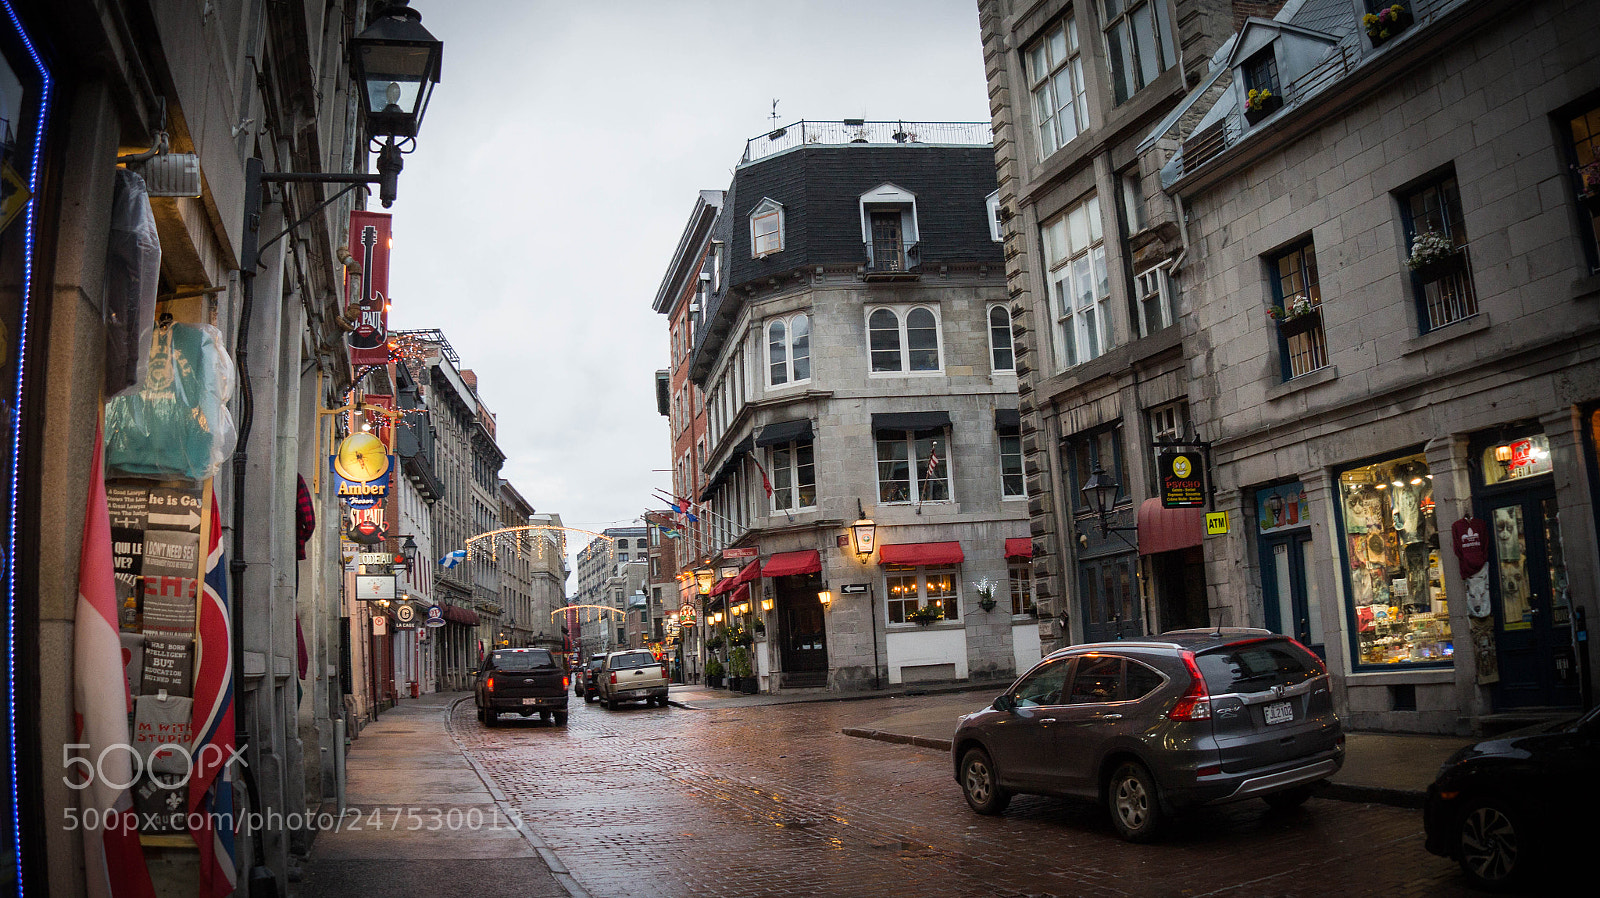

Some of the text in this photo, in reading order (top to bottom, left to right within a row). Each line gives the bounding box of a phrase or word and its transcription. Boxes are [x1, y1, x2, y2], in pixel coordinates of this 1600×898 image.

[362, 311, 383, 336] PAUL
[337, 480, 386, 496] Amber
[1166, 480, 1201, 489] PSYCHO
[148, 493, 203, 509] he is Gay
[350, 508, 386, 533] ST. PAUL
[1209, 517, 1226, 529] ATM
[114, 541, 143, 555] QUI LE
[149, 541, 167, 557] DON'T
[167, 544, 182, 559] NEED
[183, 545, 195, 560] SEX
[114, 556, 133, 569] VE?
[151, 641, 165, 649] WAS
[153, 657, 175, 668] BUT
[144, 666, 182, 677] EDUCATION
[144, 673, 170, 683] RUINED
